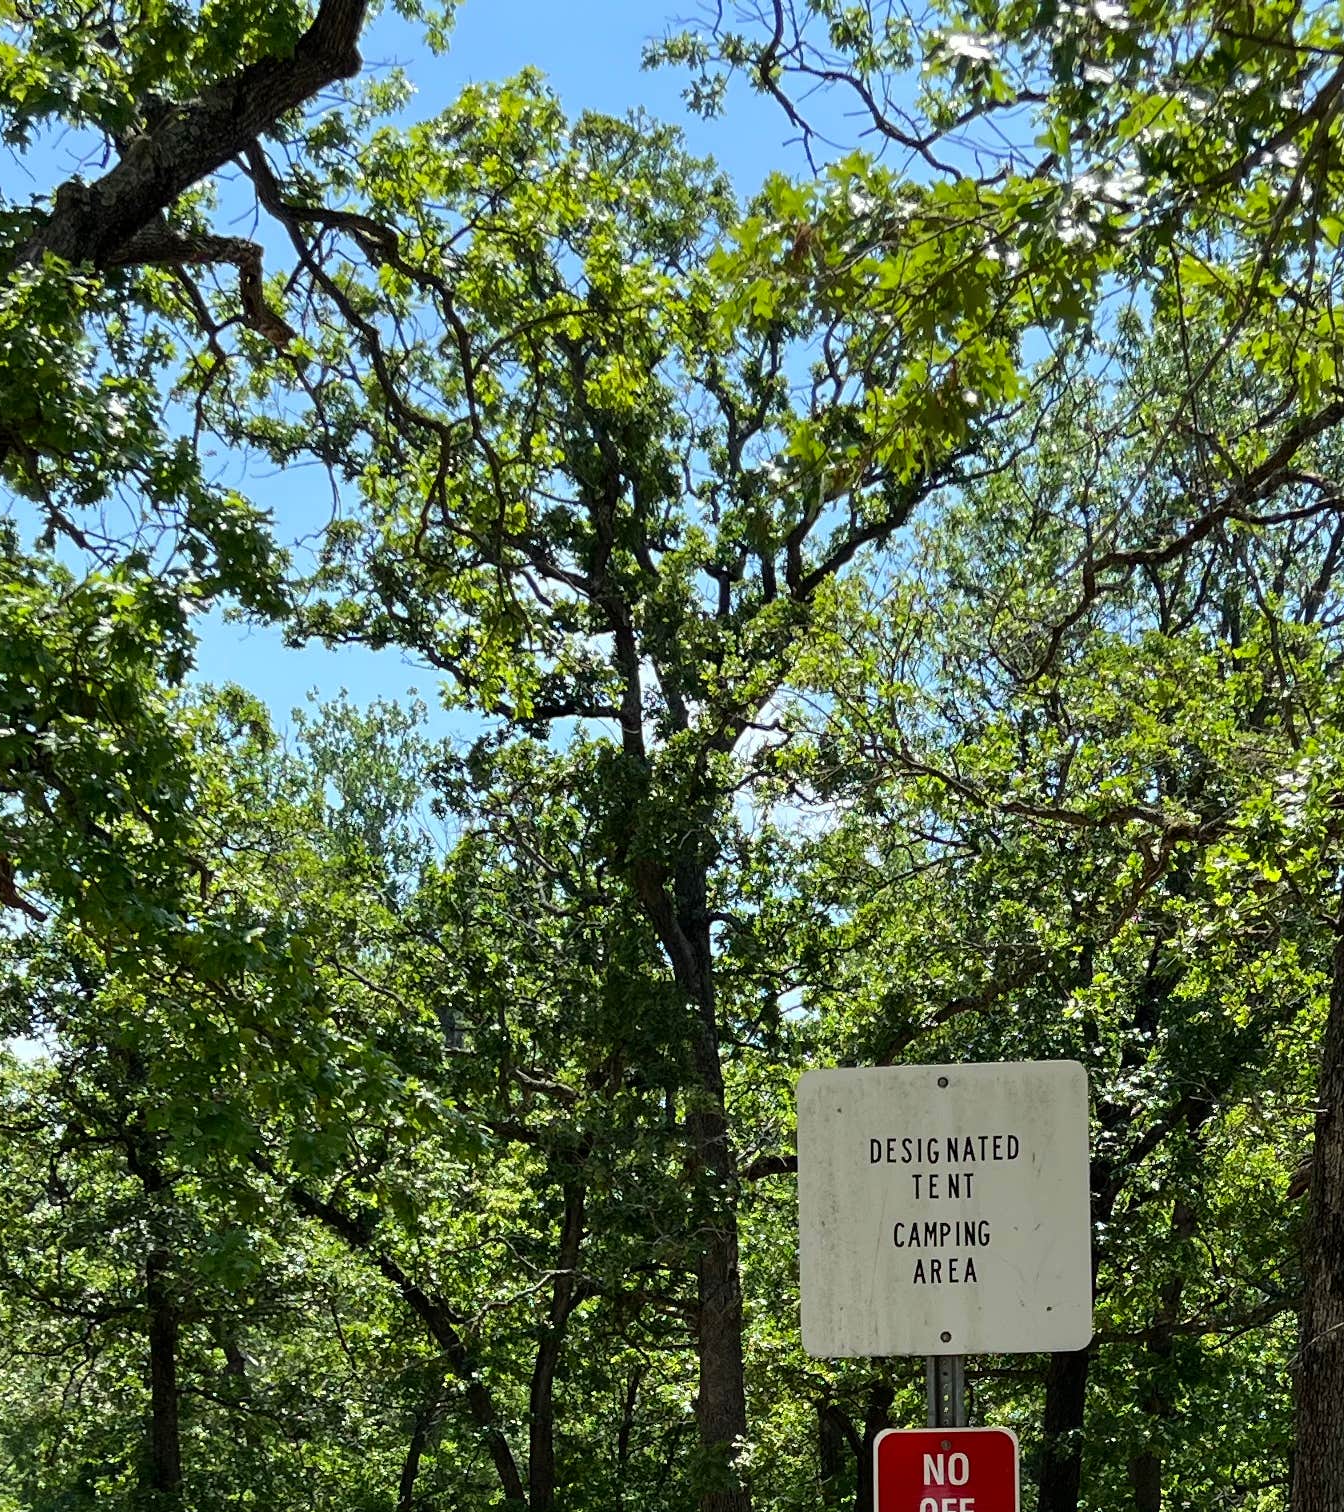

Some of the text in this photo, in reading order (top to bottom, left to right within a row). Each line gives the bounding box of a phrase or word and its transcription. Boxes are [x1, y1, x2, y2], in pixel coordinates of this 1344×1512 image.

[870, 1134, 1020, 1164] DESIGNATED
[911, 1172, 975, 1200] TENT
[893, 1220, 991, 1248] CAMPING
[912, 1257, 978, 1284] AREA
[923, 1452, 970, 1486] NO
